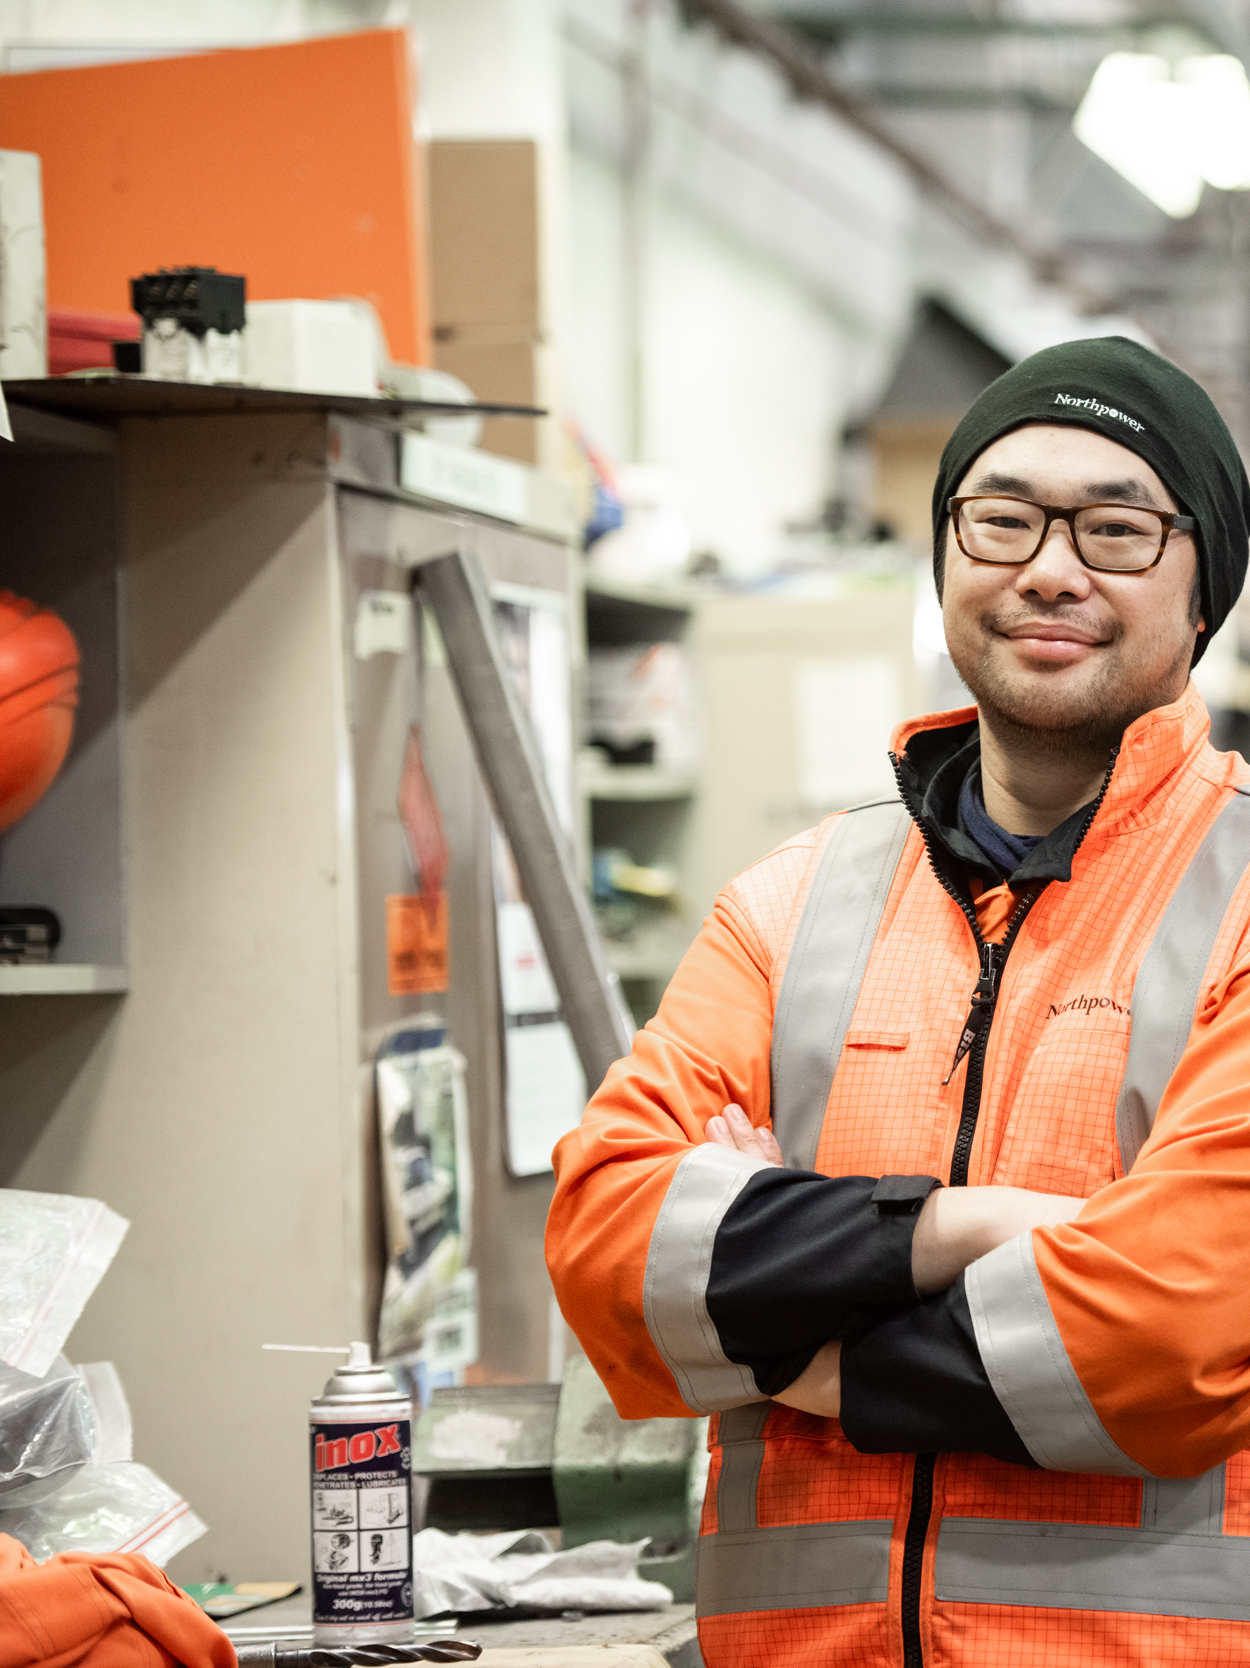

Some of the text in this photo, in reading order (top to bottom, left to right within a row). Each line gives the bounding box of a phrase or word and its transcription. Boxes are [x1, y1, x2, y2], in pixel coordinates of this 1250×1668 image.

[1054, 393, 1146, 433] Northpower
[1045, 994, 1131, 1020] Northpow
[316, 1424, 401, 1472] inox
[354, 1471, 397, 1480] PROTECTS
[332, 1600, 362, 1611] 300g
